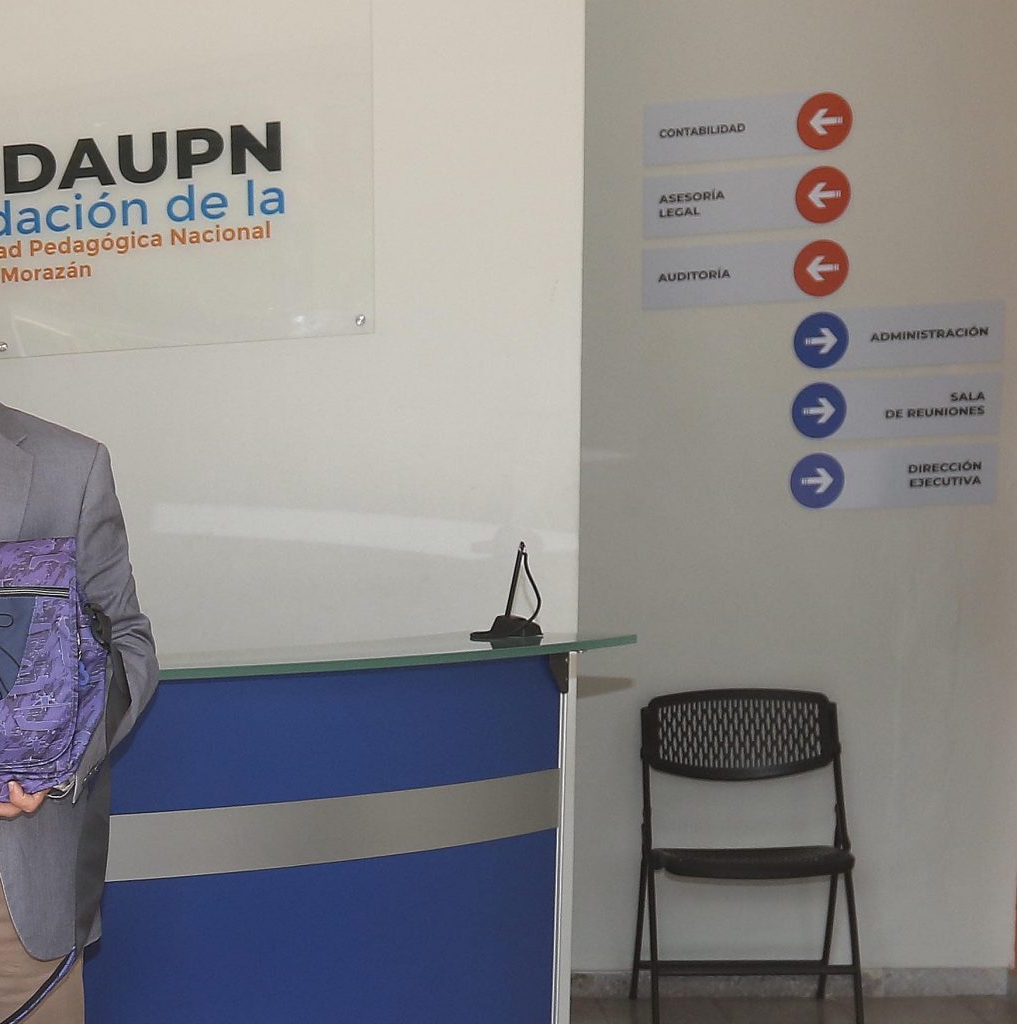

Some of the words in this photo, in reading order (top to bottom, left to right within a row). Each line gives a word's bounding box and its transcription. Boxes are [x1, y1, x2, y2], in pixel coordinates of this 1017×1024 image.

[659, 122, 746, 139] CONTABILIDAD
[166, 183, 229, 223] de
[247, 179, 286, 217] la
[659, 188, 725, 204] ASESORÍA
[659, 206, 700, 218] LEGAL
[30, 231, 163, 257] Pedagógica
[170, 221, 271, 246] Nacional
[1, 261, 91, 284] Morazán
[658, 266, 731, 282] AUDITORÍA
[870, 324, 989, 342] ADMINISTRACIÓN
[950, 391, 986, 402] SALA
[885, 409, 903, 419] DE
[907, 405, 986, 419] REUNIONES
[908, 459, 983, 474] DIRECCIÓN
[909, 476, 982, 489] EJECUTIVA
